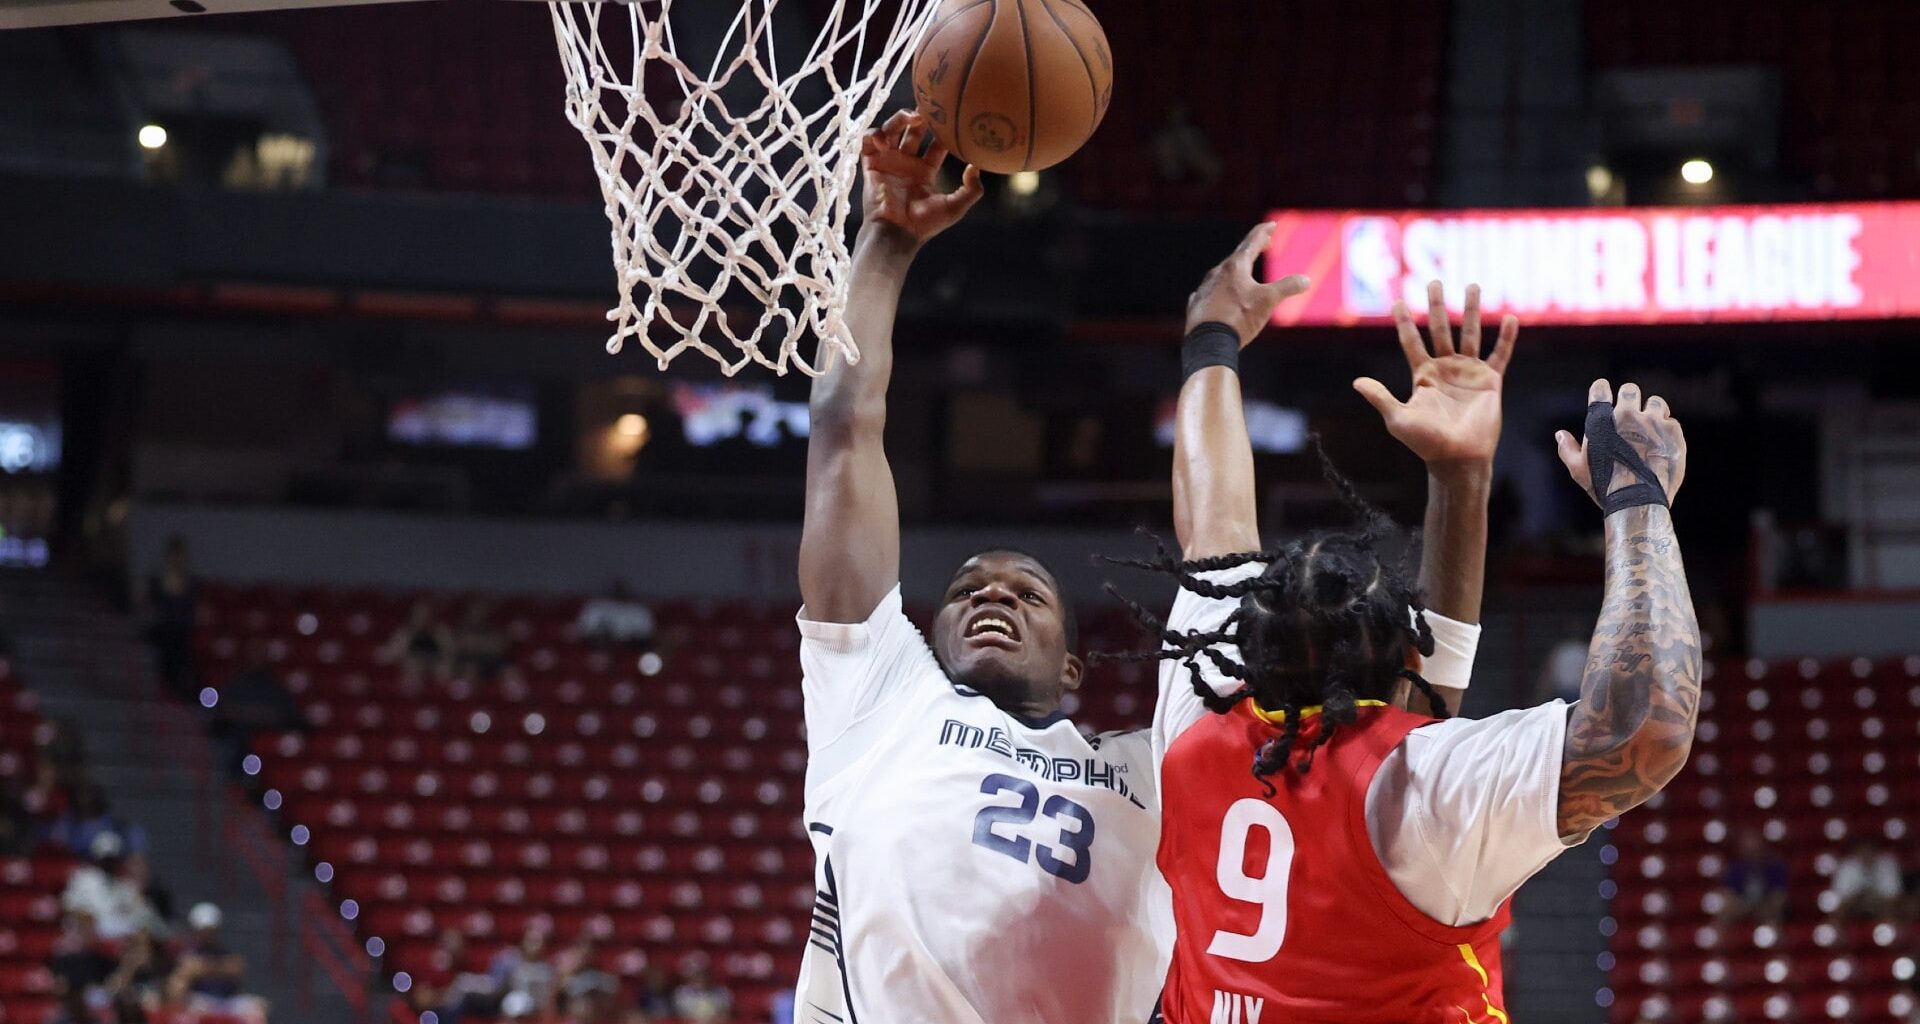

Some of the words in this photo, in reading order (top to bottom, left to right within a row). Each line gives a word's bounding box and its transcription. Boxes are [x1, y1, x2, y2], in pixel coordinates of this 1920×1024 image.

[1401, 217, 1649, 313] SUMMER
[1652, 213, 1863, 309] LEAGUE
[938, 719, 1147, 810] MEMPHI
[972, 773, 1095, 884] 23
[1206, 797, 1295, 963] 9
